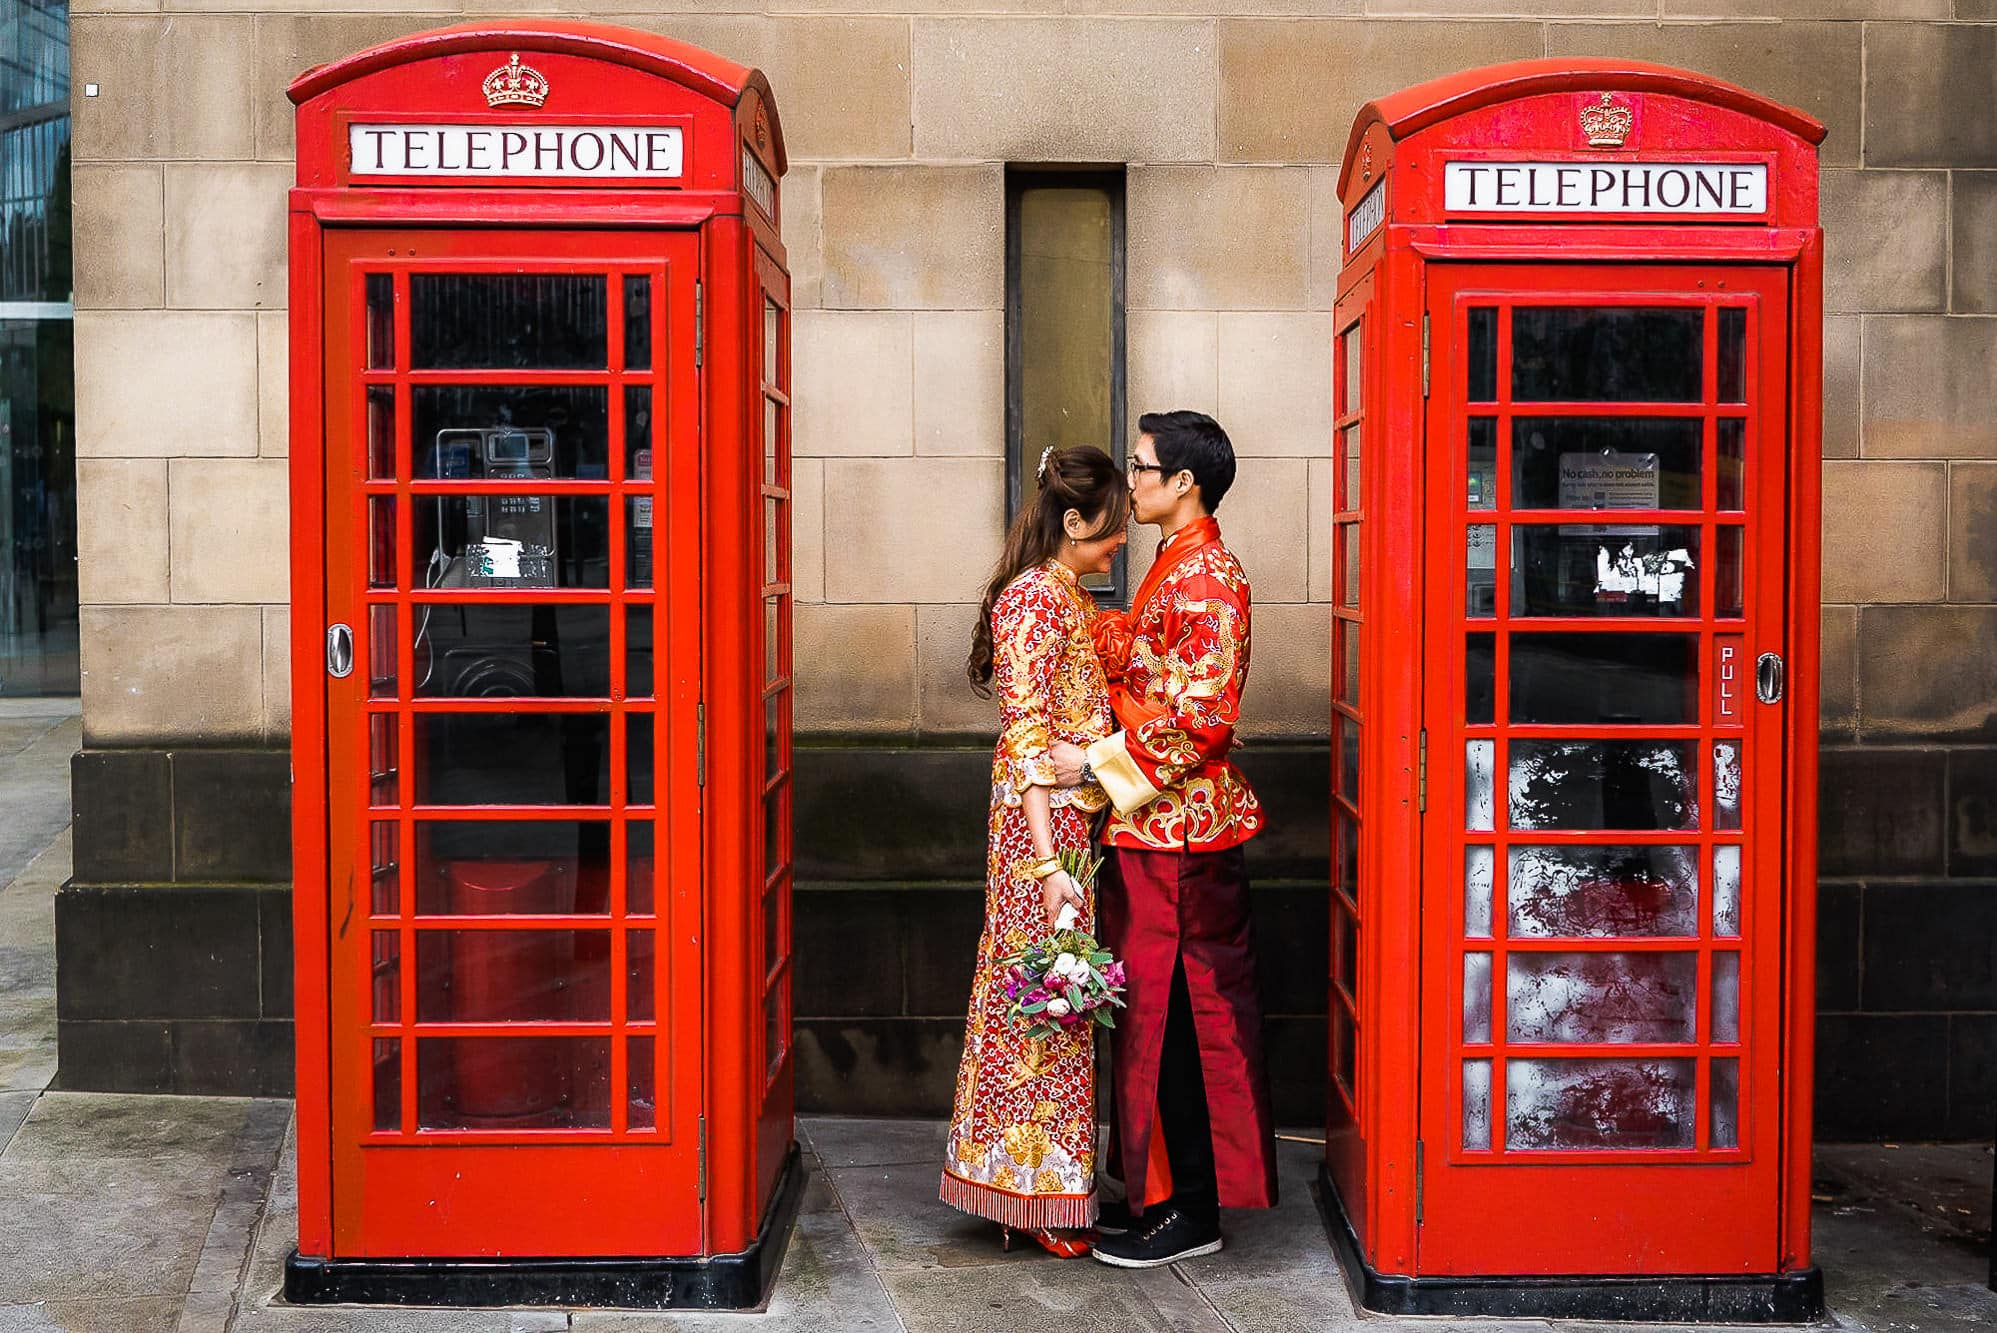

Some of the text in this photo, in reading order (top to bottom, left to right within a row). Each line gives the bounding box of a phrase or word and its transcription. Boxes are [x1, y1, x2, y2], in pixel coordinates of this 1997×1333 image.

[365, 131, 671, 171] TELEPHONE
[1458, 168, 1753, 209] TELEPHONE
[1562, 468, 1576, 479] No
[1602, 471, 1614, 479] no
[1615, 468, 1655, 480] problem
[1722, 647, 1733, 715] PULL
